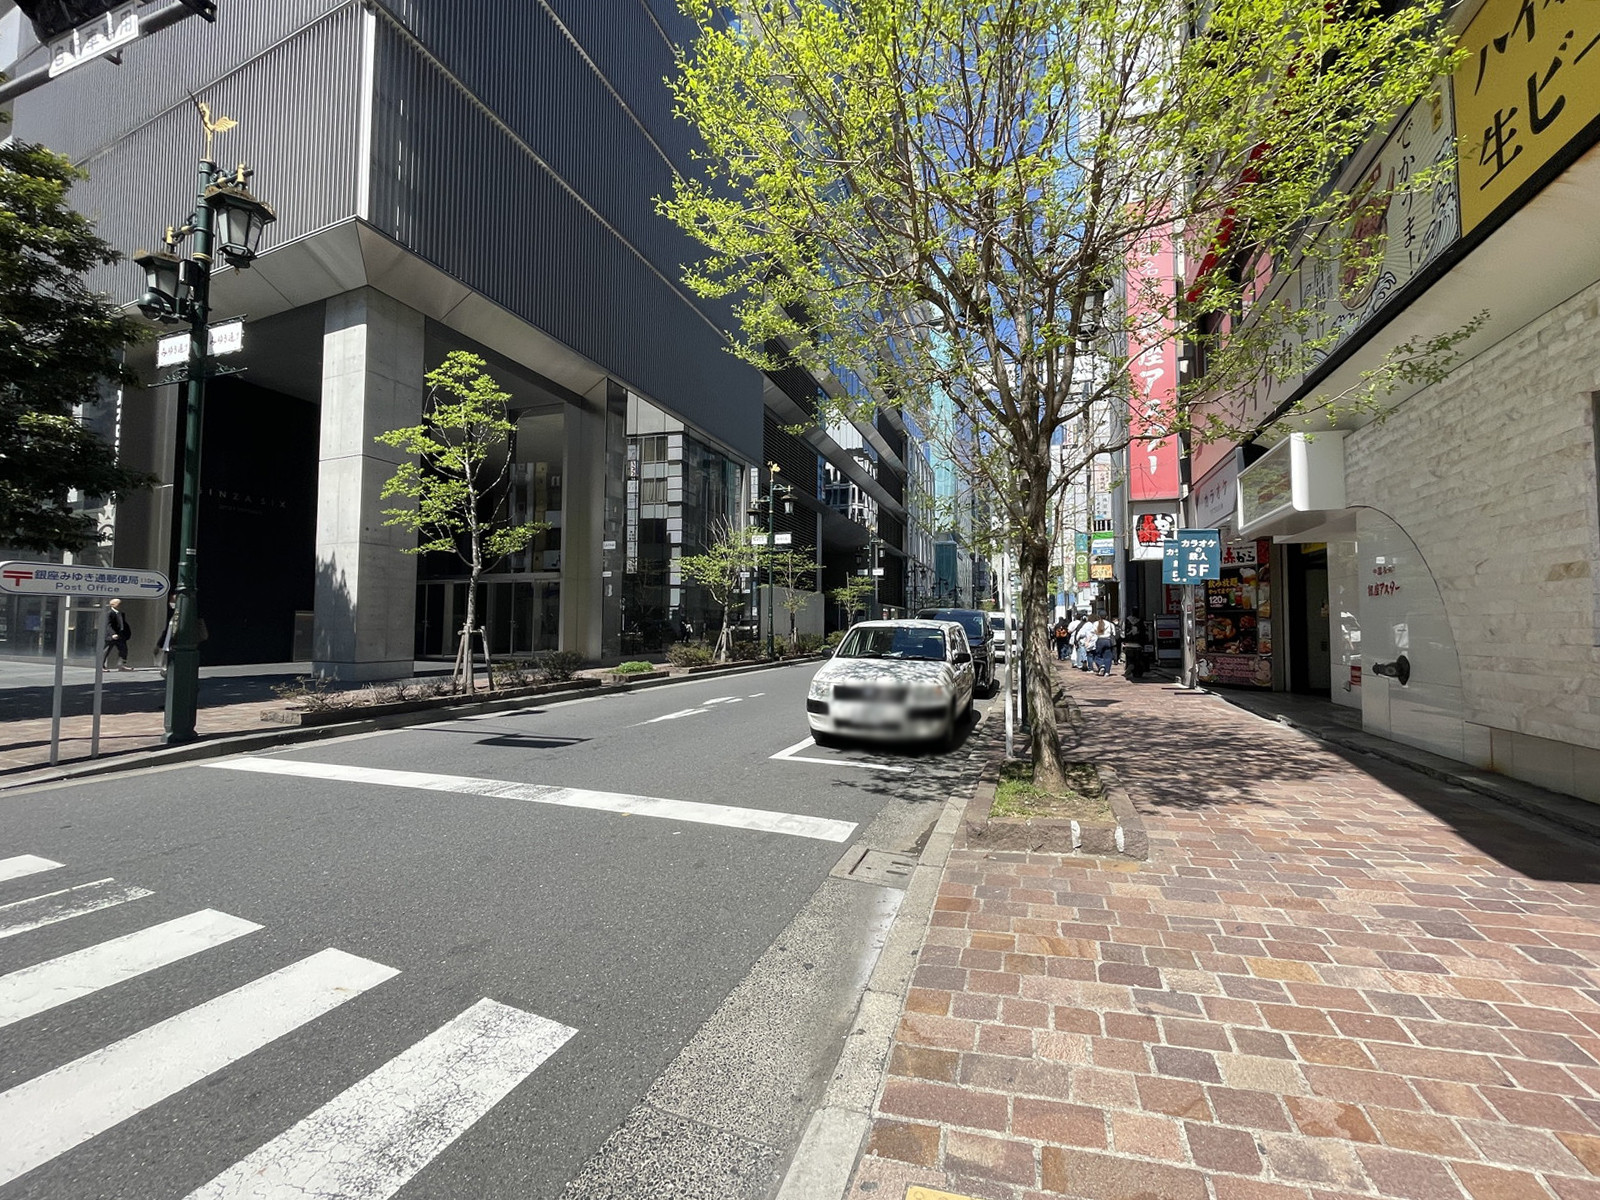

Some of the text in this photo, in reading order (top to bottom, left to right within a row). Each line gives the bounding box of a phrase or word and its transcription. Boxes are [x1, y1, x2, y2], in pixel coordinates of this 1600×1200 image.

[1474, 0, 1566, 97] ハイ
[199, 488, 253, 503] INZA
[1181, 539, 1217, 548] カラオケ
[1188, 552, 1208, 561] 鉄人
[1223, 547, 1255, 564] 赤から
[35, 569, 139, 585] 銀座みゆき通郵便局
[1187, 564, 1210, 577] 5F
[56, 583, 120, 593] Post Office
